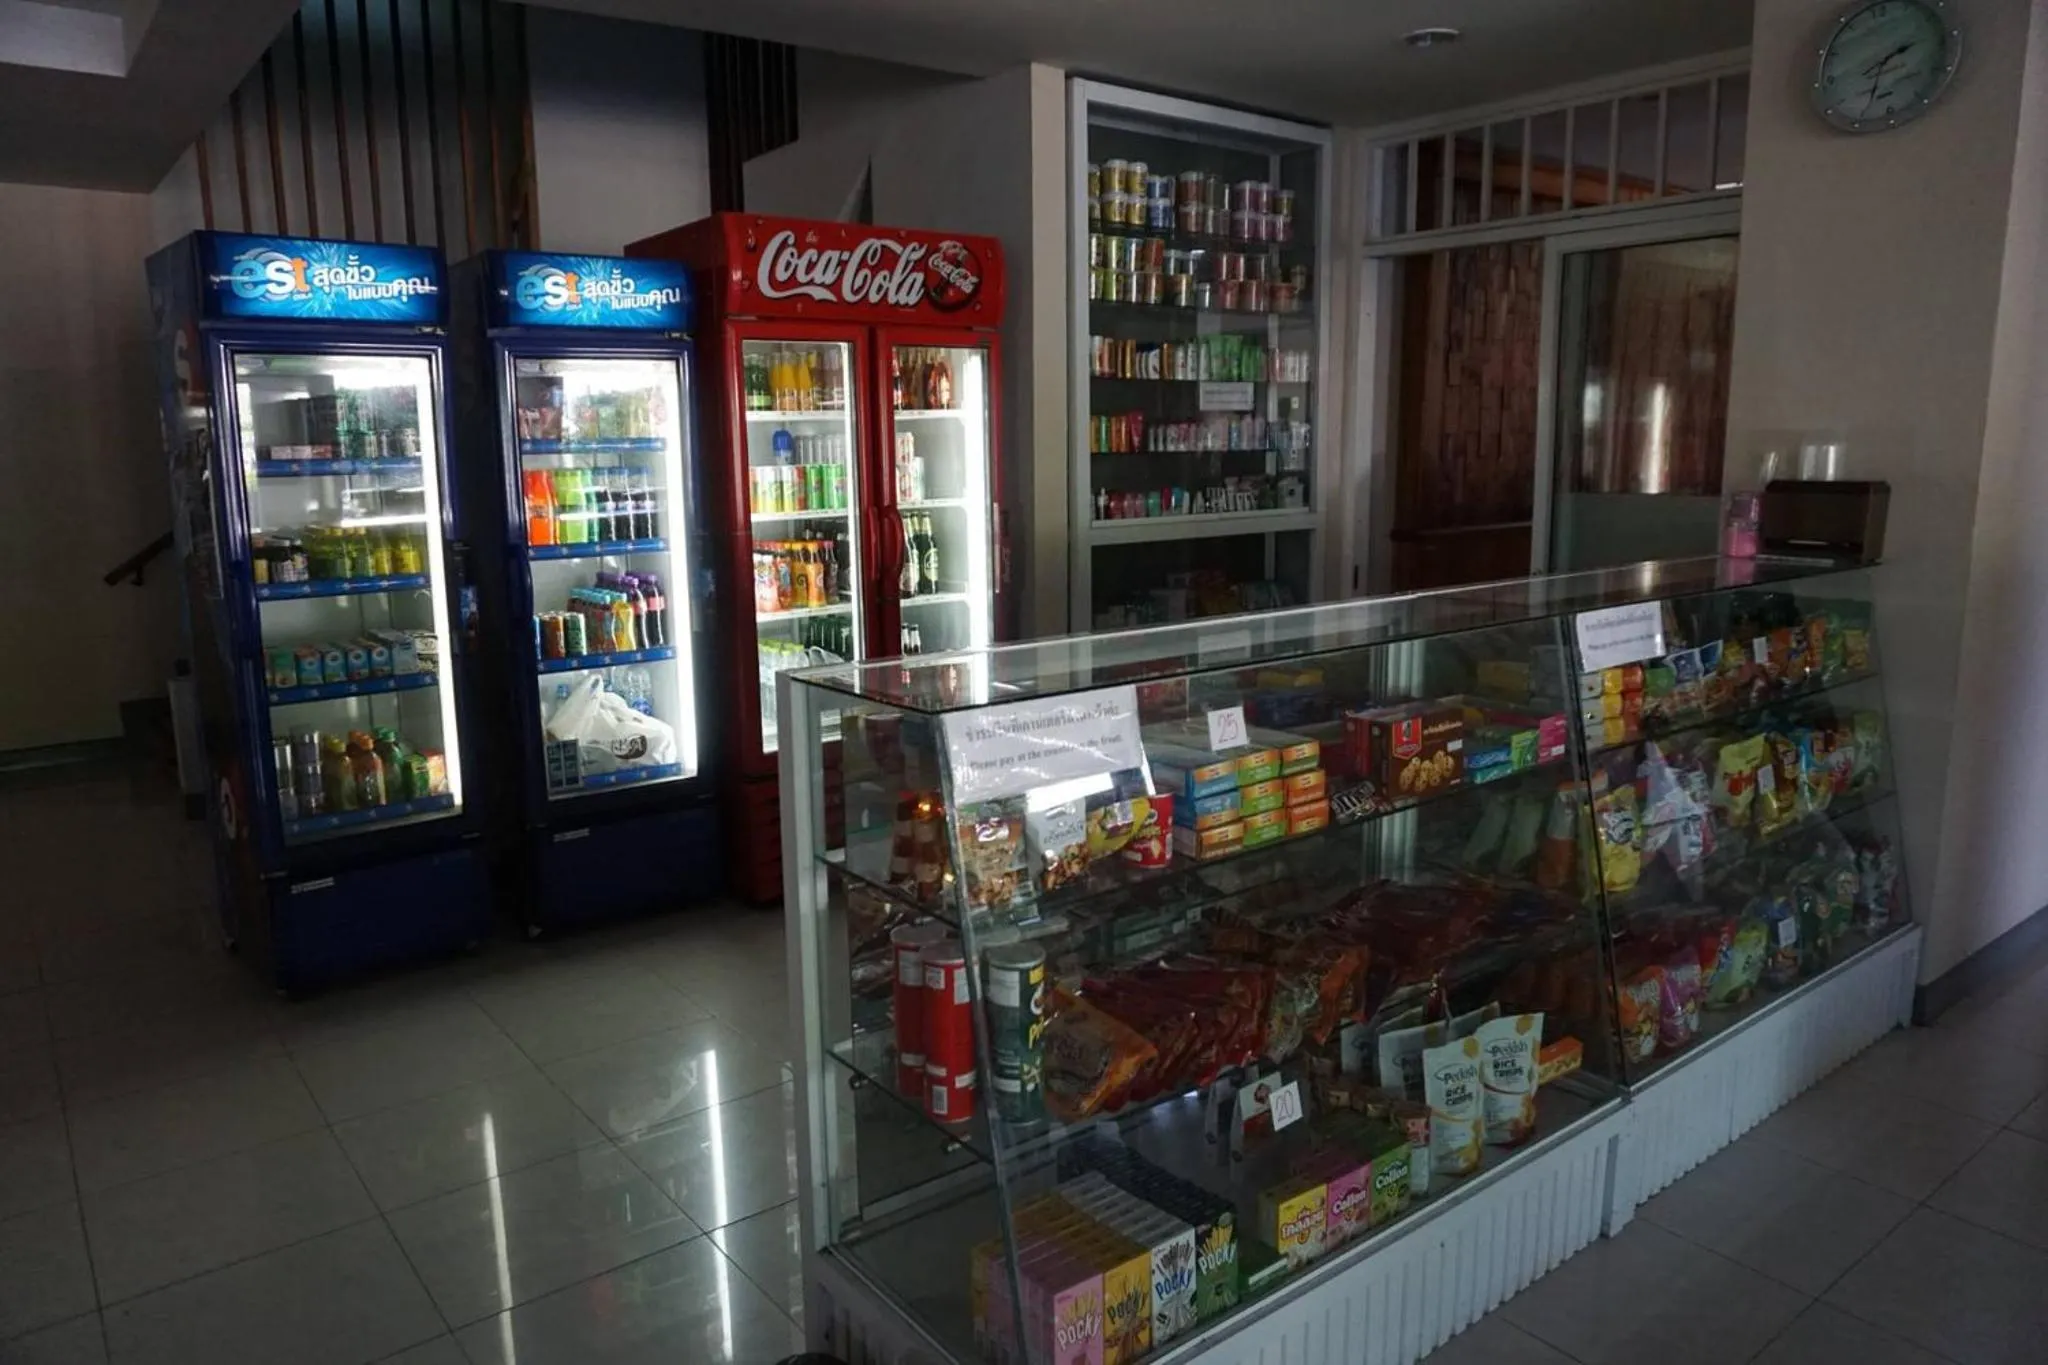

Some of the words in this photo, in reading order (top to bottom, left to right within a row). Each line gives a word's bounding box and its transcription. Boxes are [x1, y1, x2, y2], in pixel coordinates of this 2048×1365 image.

[231, 256, 309, 299] est
[757, 231, 927, 306] Coca-Cola
[516, 271, 581, 310] est
[1217, 713, 1239, 744] 25
[1000, 756, 1014, 767] pay
[1017, 752, 1026, 762] at
[1028, 750, 1041, 760] the
[1275, 1089, 1294, 1122] 20
[1375, 1164, 1409, 1190] Collon
[1197, 1238, 1238, 1275] POCKY
[1155, 1269, 1194, 1300] POCKY
[1107, 1289, 1147, 1325] POCKY
[1056, 1312, 1103, 1351] POCKY
